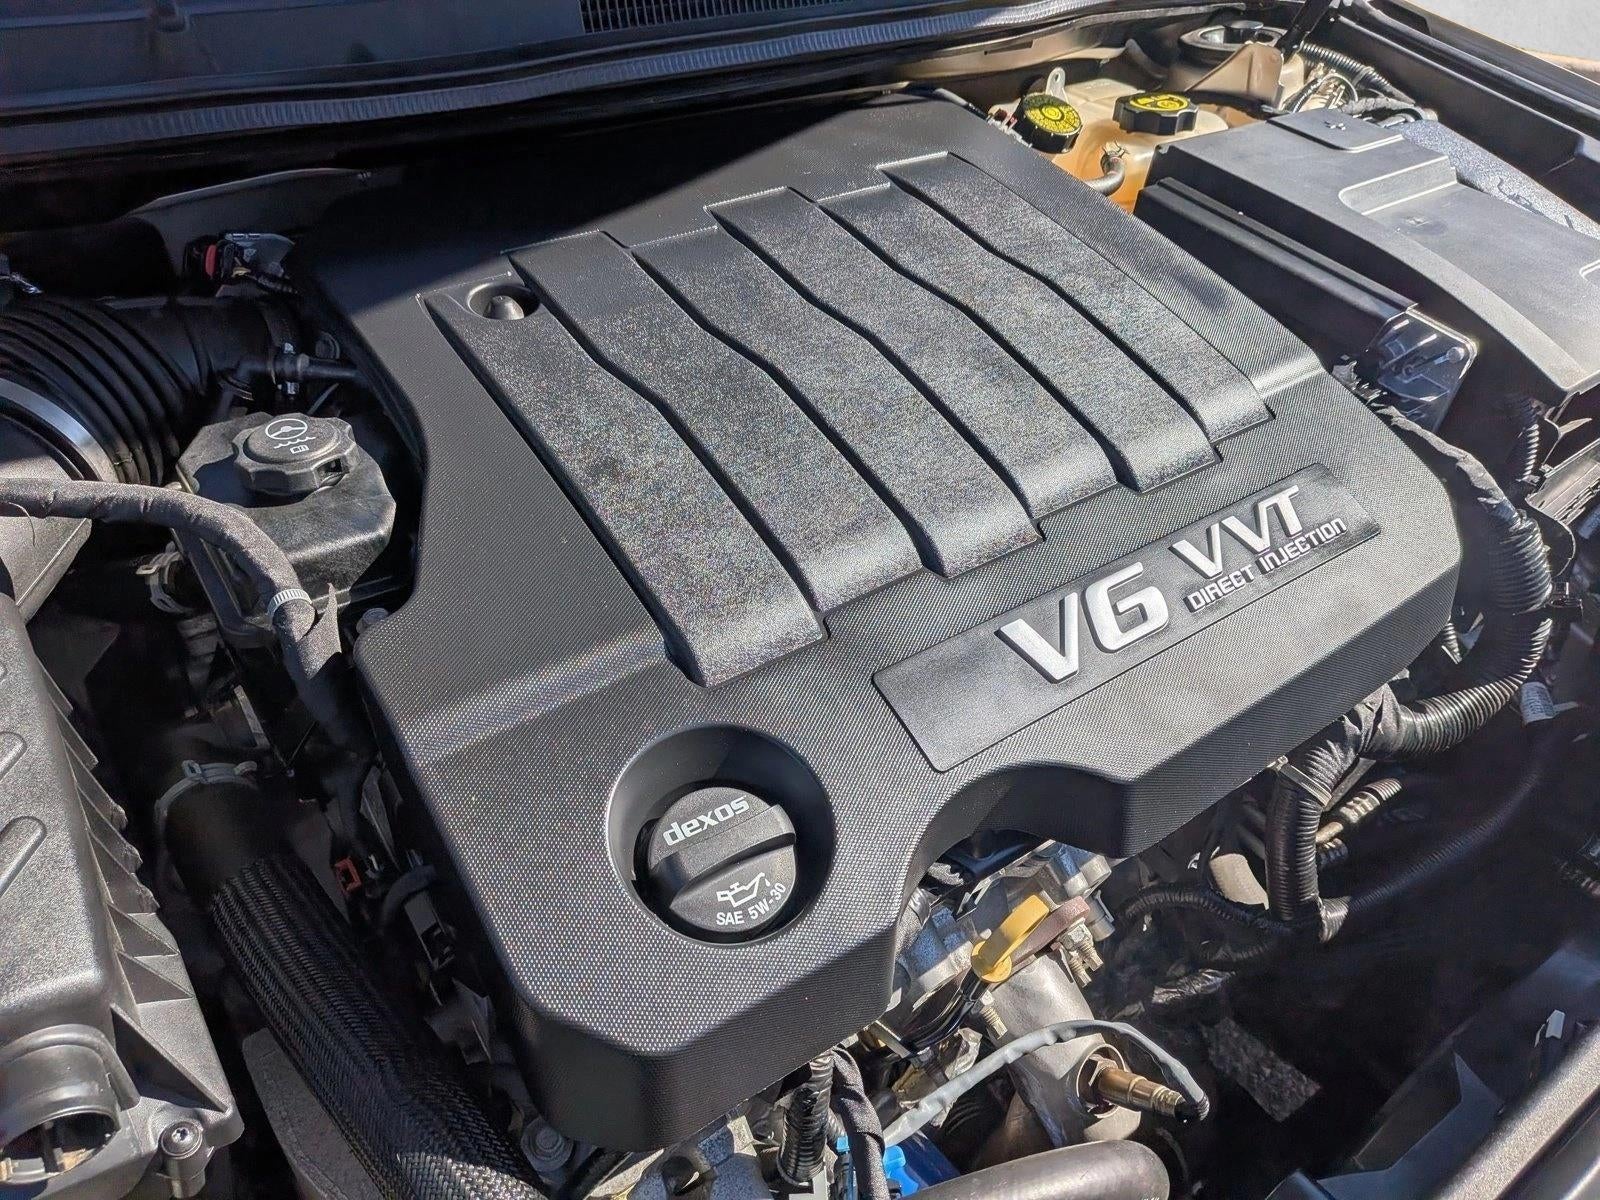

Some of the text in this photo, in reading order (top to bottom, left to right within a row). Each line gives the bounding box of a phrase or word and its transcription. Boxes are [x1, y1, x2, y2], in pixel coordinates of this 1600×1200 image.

[999, 484, 1303, 682] V6 VVT
[1187, 517, 1347, 612] DIRECT INJECTION
[662, 796, 750, 846] dexos
[716, 882, 786, 926] SAE 5W-30
